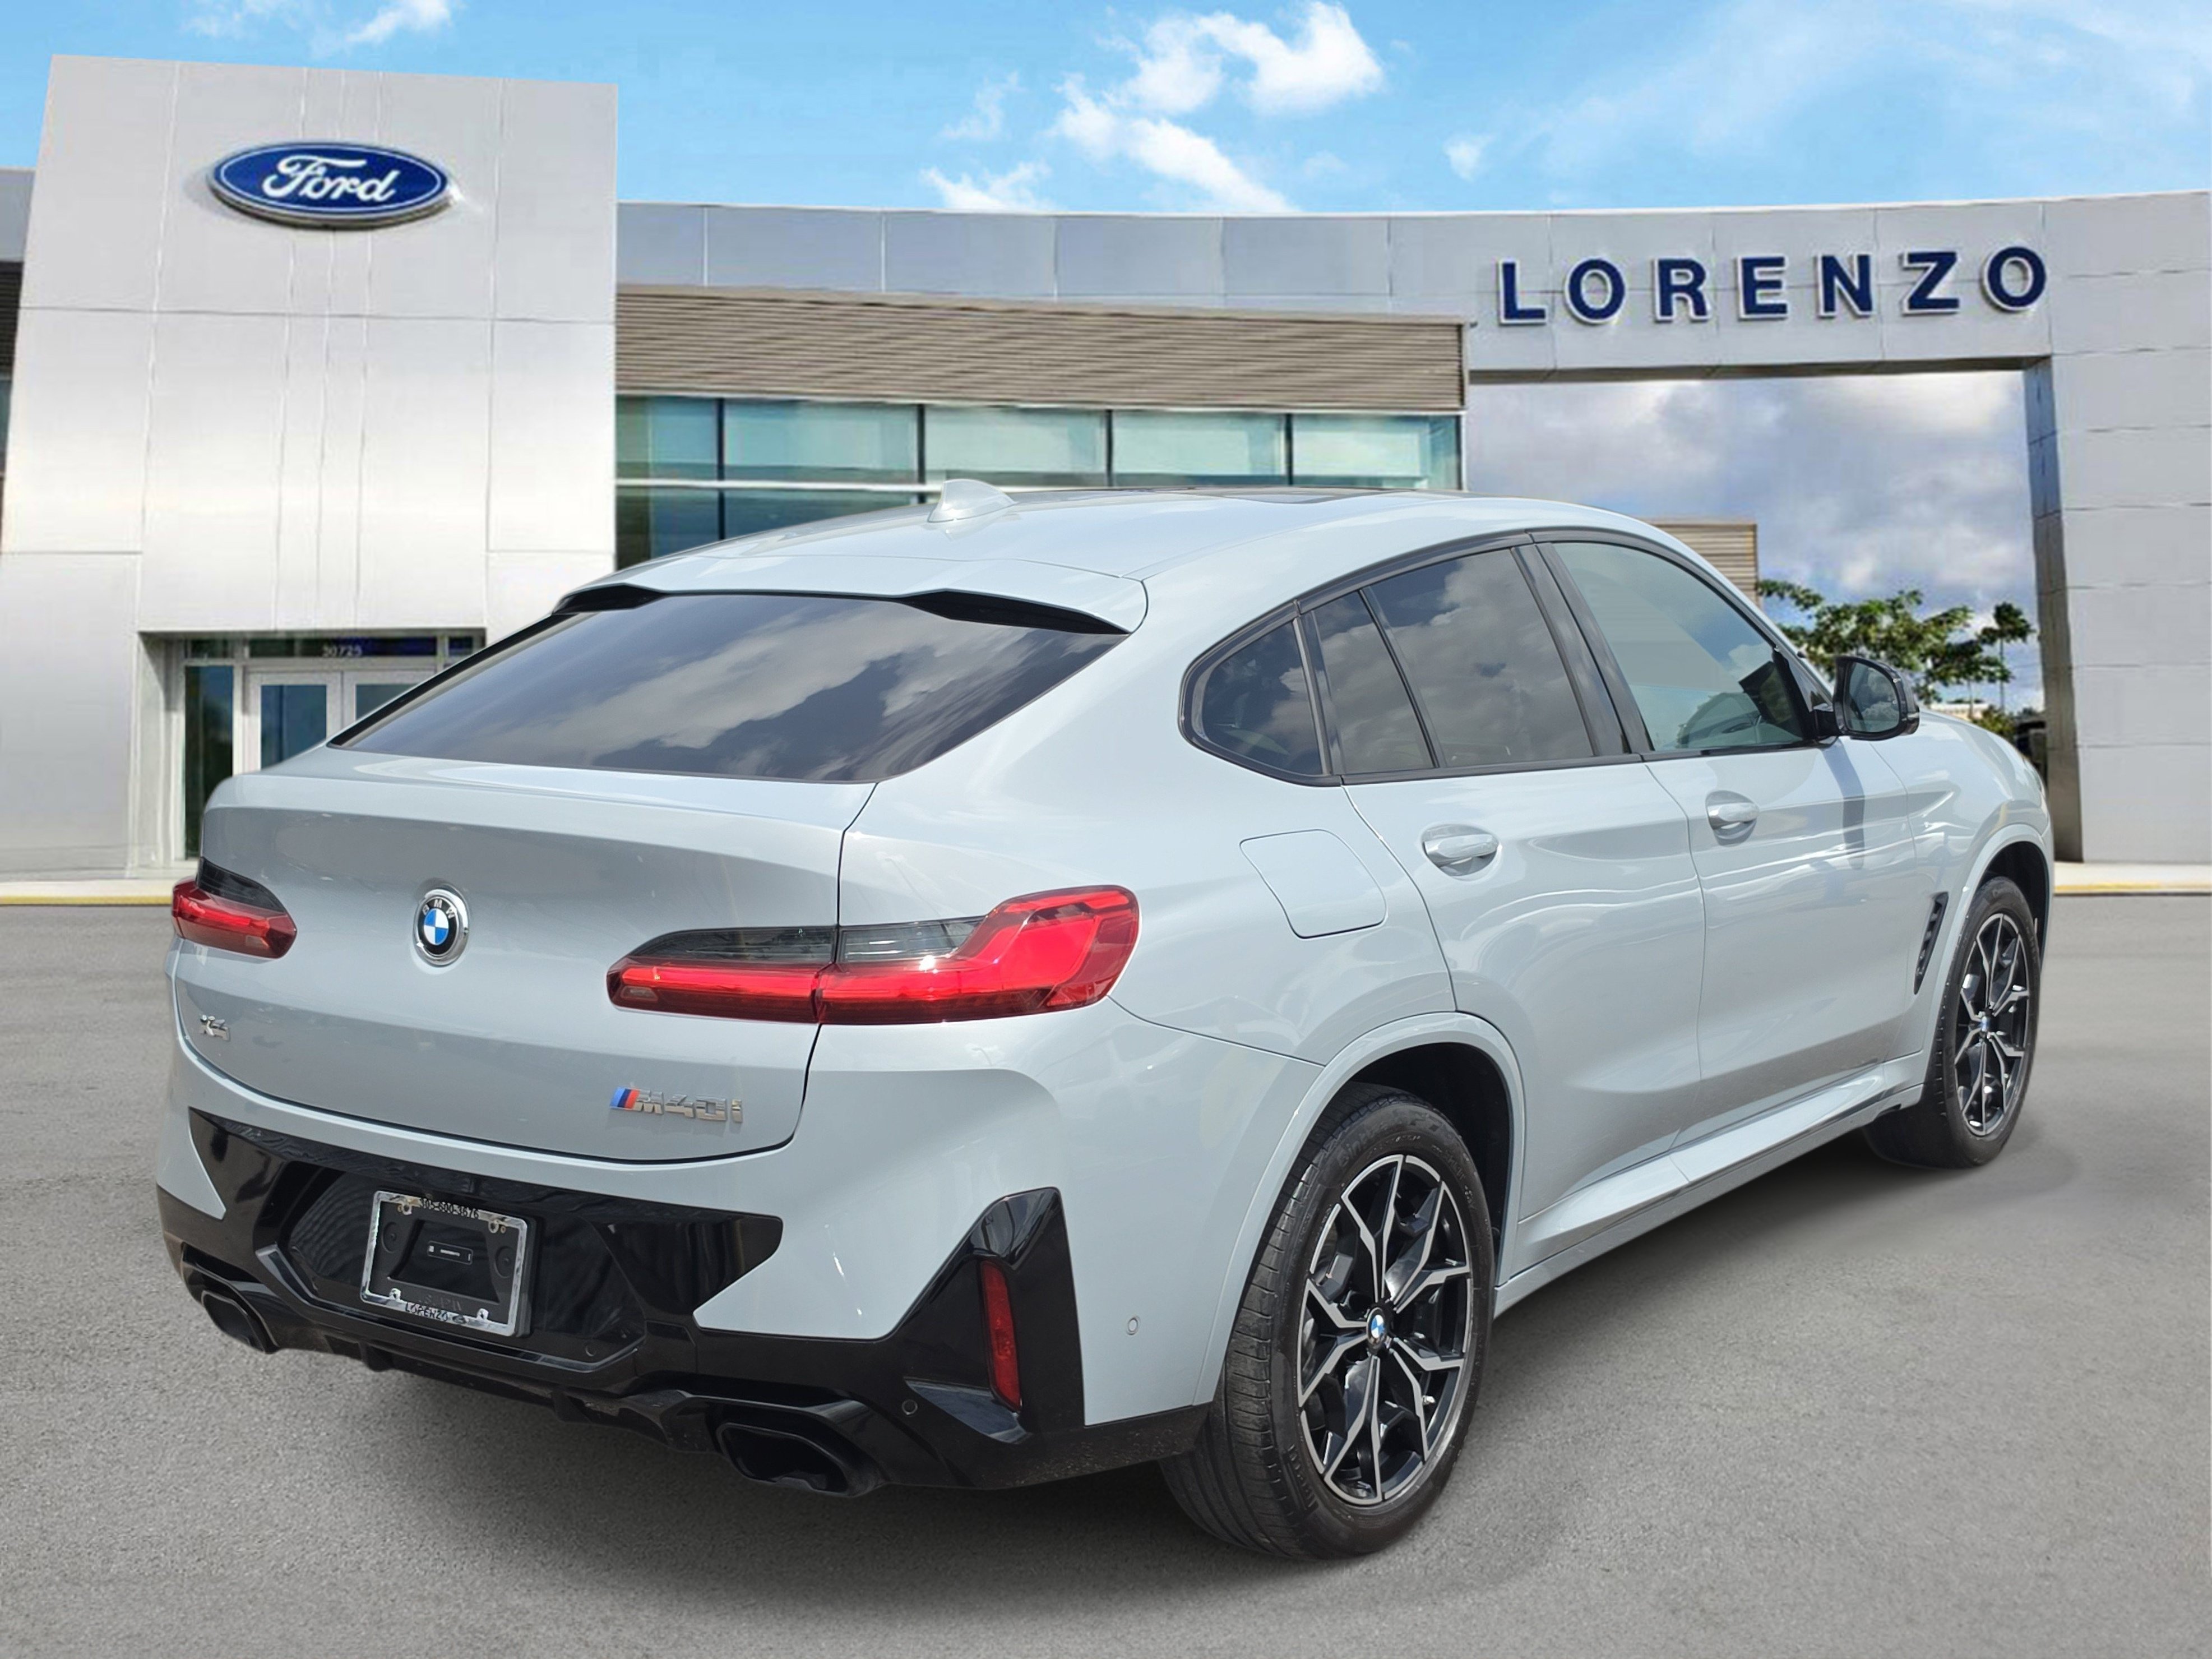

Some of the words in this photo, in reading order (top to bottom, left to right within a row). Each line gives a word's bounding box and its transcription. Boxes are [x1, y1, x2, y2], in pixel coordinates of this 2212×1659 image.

[262, 154, 401, 202] Ford
[1496, 245, 2047, 325] LORENZO
[422, 899, 455, 919] BMW
[405, 1302, 448, 1324] LORENZO
